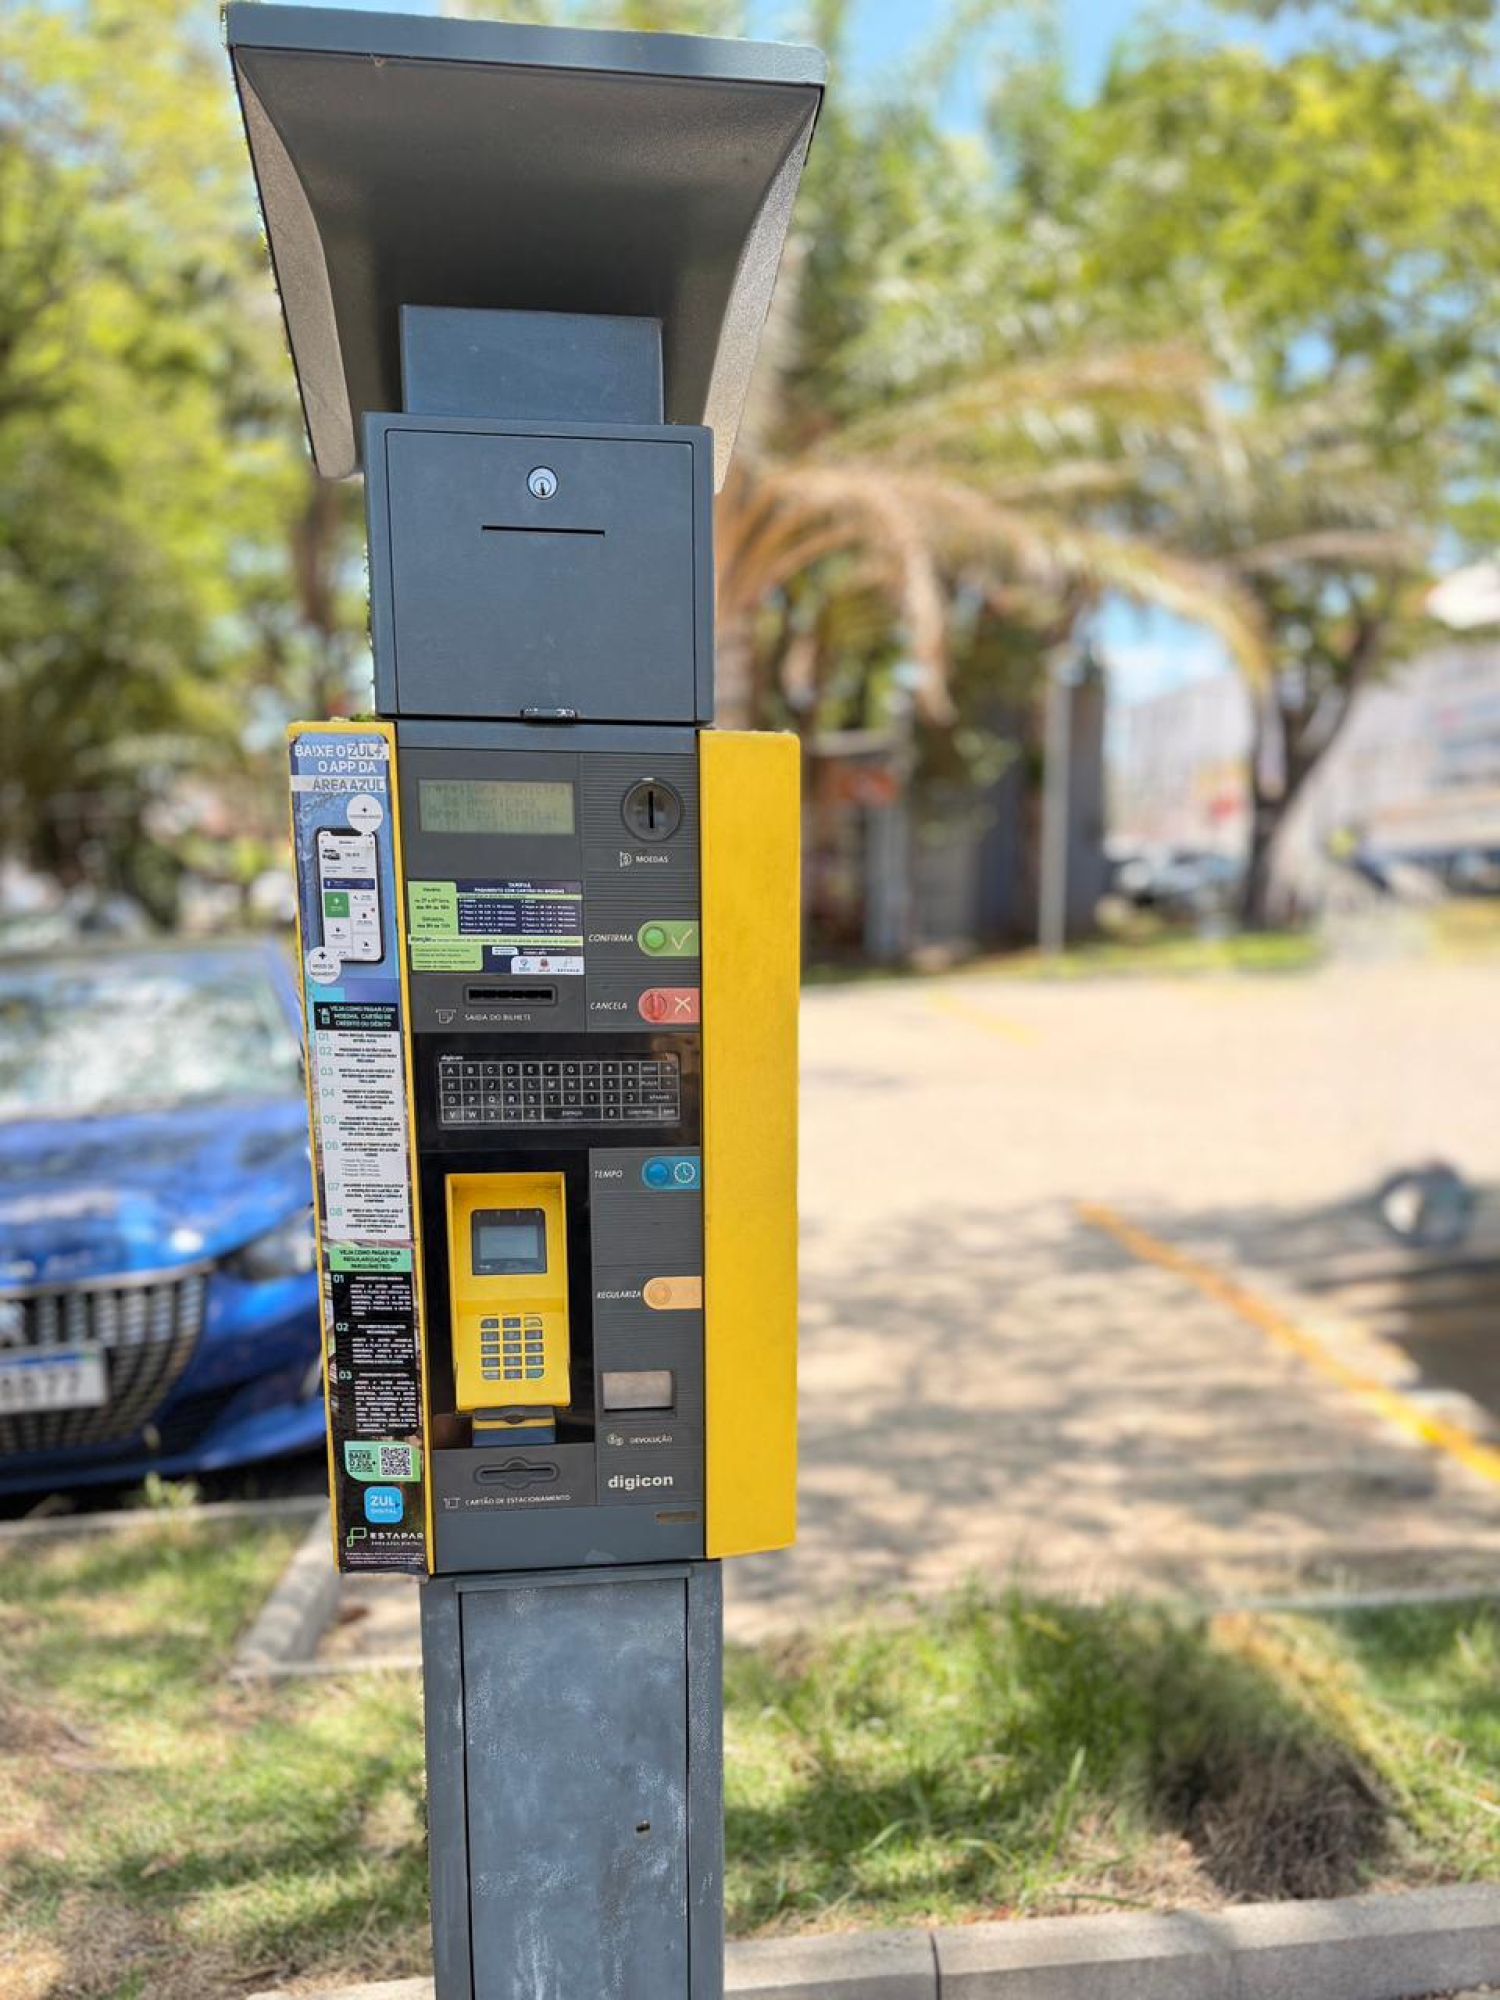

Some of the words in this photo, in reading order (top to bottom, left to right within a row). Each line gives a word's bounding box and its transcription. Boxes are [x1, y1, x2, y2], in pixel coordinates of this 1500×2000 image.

[294, 744, 334, 757] BAIXE
[335, 744, 346, 757] O
[318, 760, 327, 773] O
[329, 760, 356, 773] APP
[358, 760, 377, 773] DA
[349, 778, 385, 791] AZUL
[635, 855, 669, 864] MOEDAS
[588, 933, 634, 943] CONFIRMA
[589, 1001, 628, 1010] CANCELA
[489, 1013, 501, 1021] DO
[502, 1013, 532, 1021] BILHETE
[318, 1032, 329, 1042] 01
[319, 1046, 332, 1056] 02
[320, 1067, 334, 1076] 03
[321, 1089, 335, 1098] 04
[323, 1115, 337, 1125] 05
[593, 1169, 624, 1179] TEMPO
[327, 1182, 340, 1192] 07
[332, 1274, 345, 1284] 01
[596, 1290, 641, 1300] REGULARIZA
[335, 1322, 350, 1332] 02
[338, 1369, 353, 1380] 03
[629, 1433, 674, 1445] DEVOLUÇÃO
[607, 1474, 675, 1492] digicon
[464, 1495, 491, 1508] CARTÃO
[492, 1496, 505, 1506] DE
[506, 1493, 572, 1505] ESTACIONAMENTO
[369, 1532, 424, 1541] ESTAPAR
